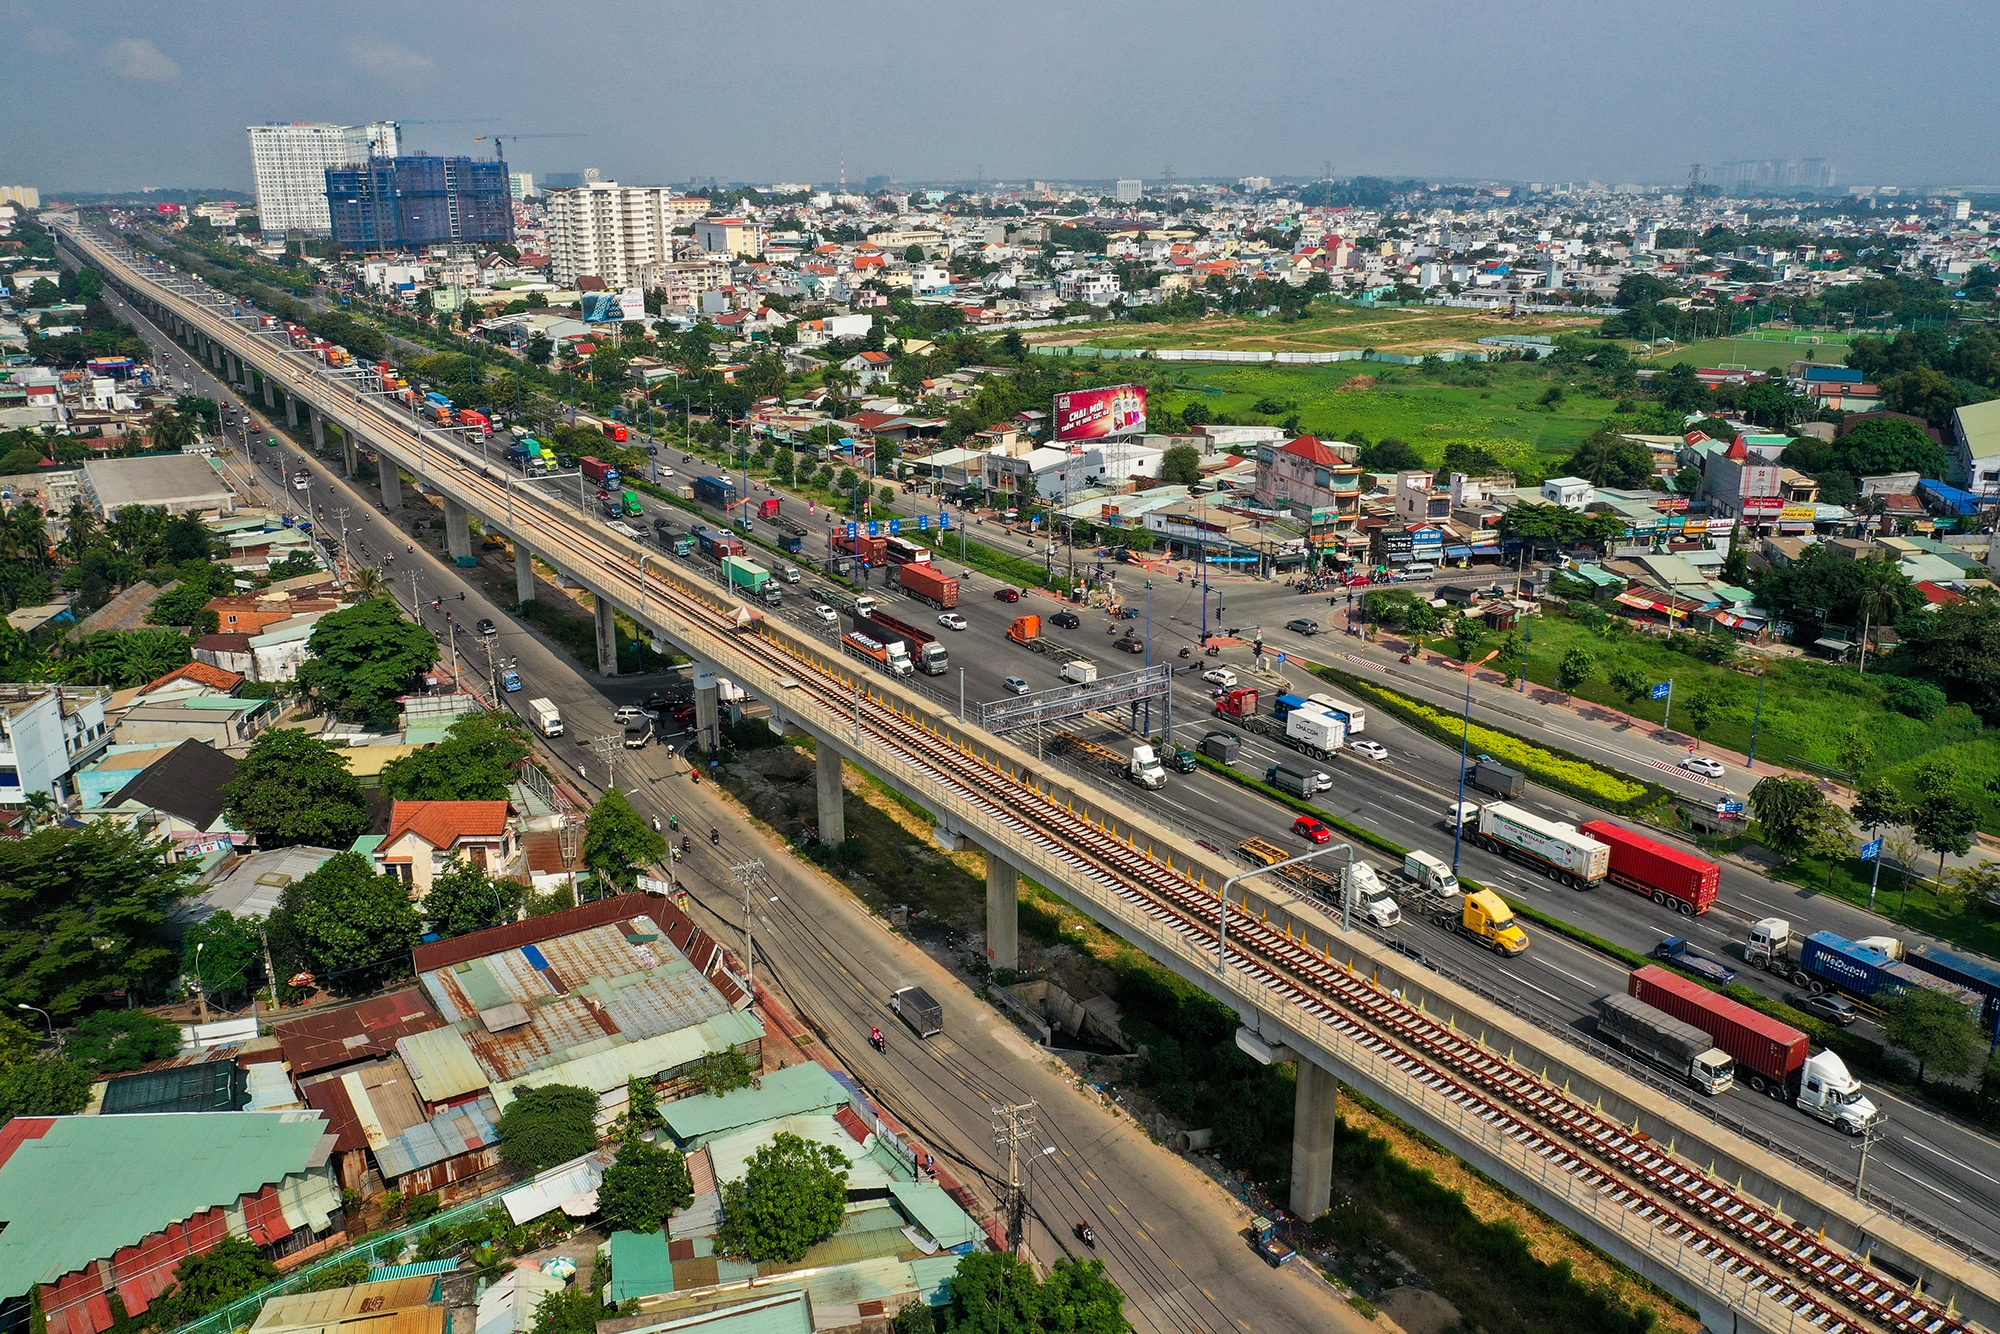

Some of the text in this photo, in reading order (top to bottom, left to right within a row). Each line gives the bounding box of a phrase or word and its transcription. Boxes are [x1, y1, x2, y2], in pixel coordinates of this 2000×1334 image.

[1069, 408, 1087, 422] CHAI
[1503, 824, 1518, 833] CNG
[1519, 831, 1546, 845] VIETNAM
[1815, 950, 1868, 979] NileDutch
